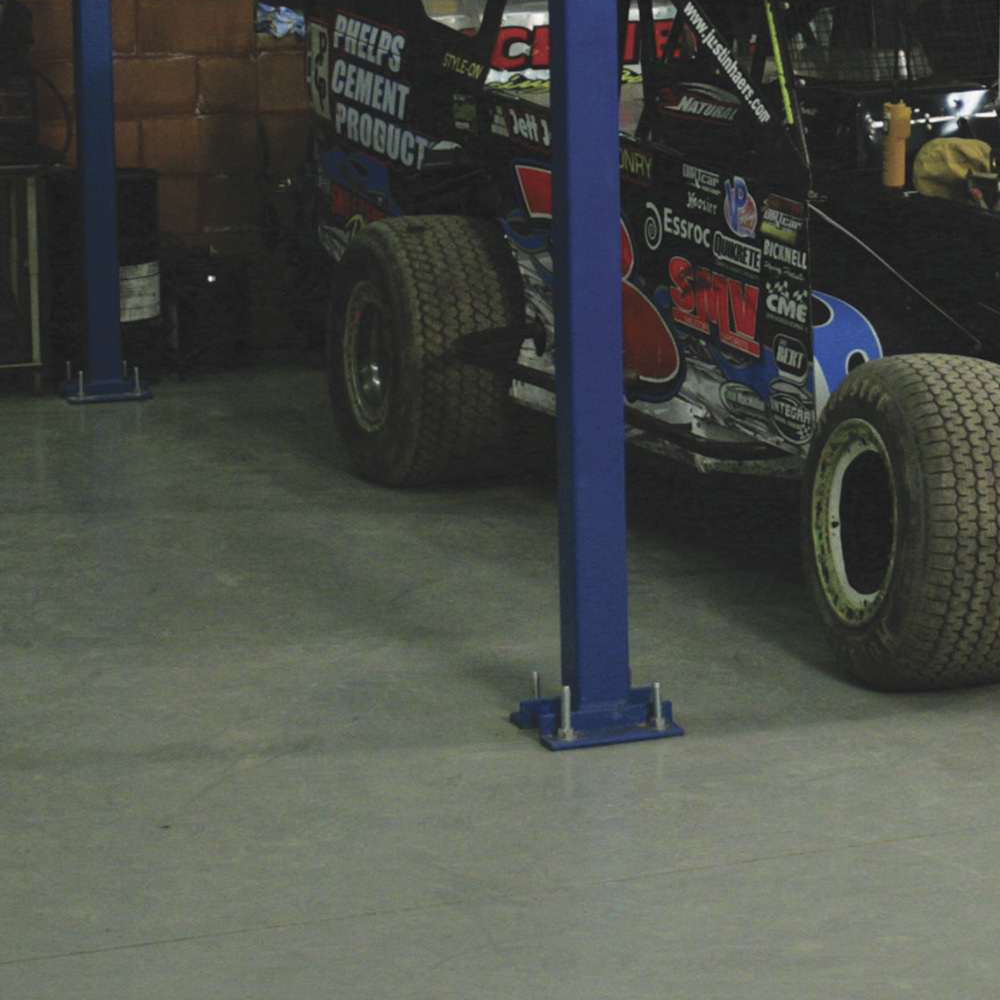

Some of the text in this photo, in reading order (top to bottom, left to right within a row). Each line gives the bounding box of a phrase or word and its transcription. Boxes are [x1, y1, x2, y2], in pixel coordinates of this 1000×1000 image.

[332, 13, 406, 73] PHELPS
[683, 1, 771, 123] www.justinhaers.com
[332, 58, 411, 120] CEMENT
[663, 206, 711, 249] Essroc
[763, 239, 807, 270] BICKNELL
[766, 294, 808, 324] CME
